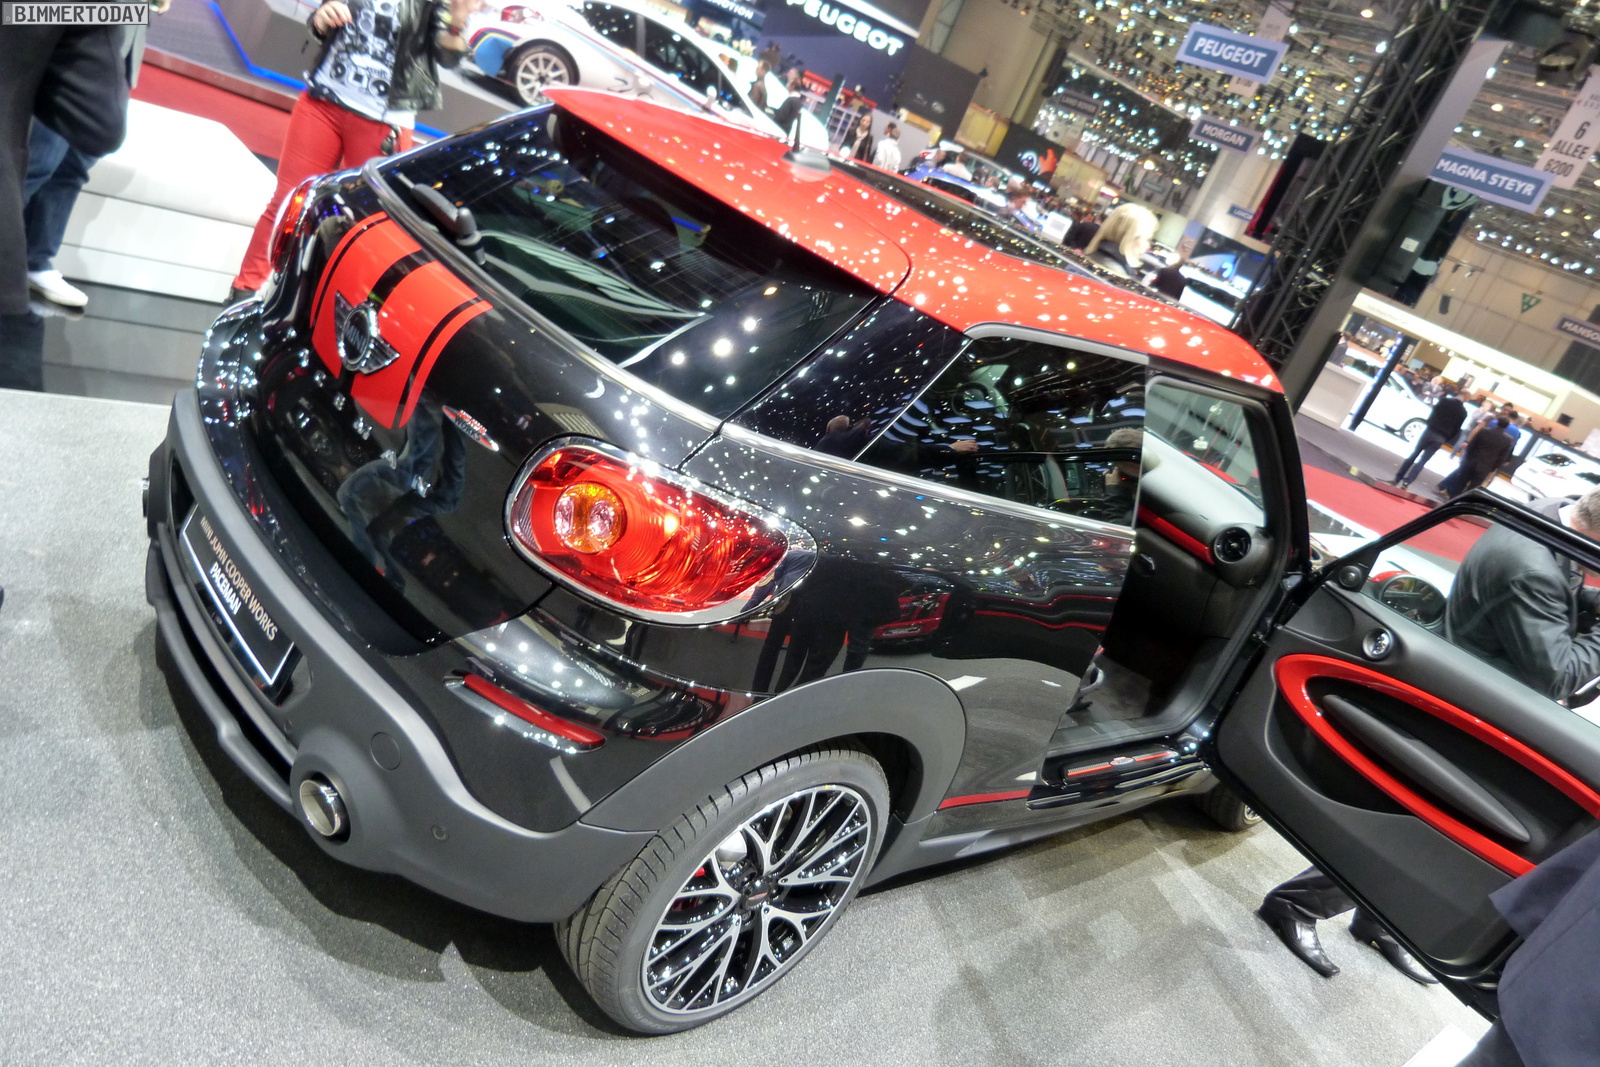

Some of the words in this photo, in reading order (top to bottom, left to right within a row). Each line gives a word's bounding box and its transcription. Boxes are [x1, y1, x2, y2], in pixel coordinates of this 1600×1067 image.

[1193, 37, 1268, 68] PEUGEOT
[1201, 123, 1247, 147] MORGAN
[1574, 121, 1591, 140] 6
[1550, 139, 1590, 160] ALLEE
[1436, 158, 1488, 183] MAGNA
[1488, 173, 1536, 197] STEYR
[1543, 158, 1574, 178] 6200
[1561, 320, 1600, 342] MANSO
[200, 516, 214, 540] MINI
[225, 559, 252, 604] COOPER
[248, 595, 278, 641] WORKS
[209, 561, 242, 616] PACEMAN
